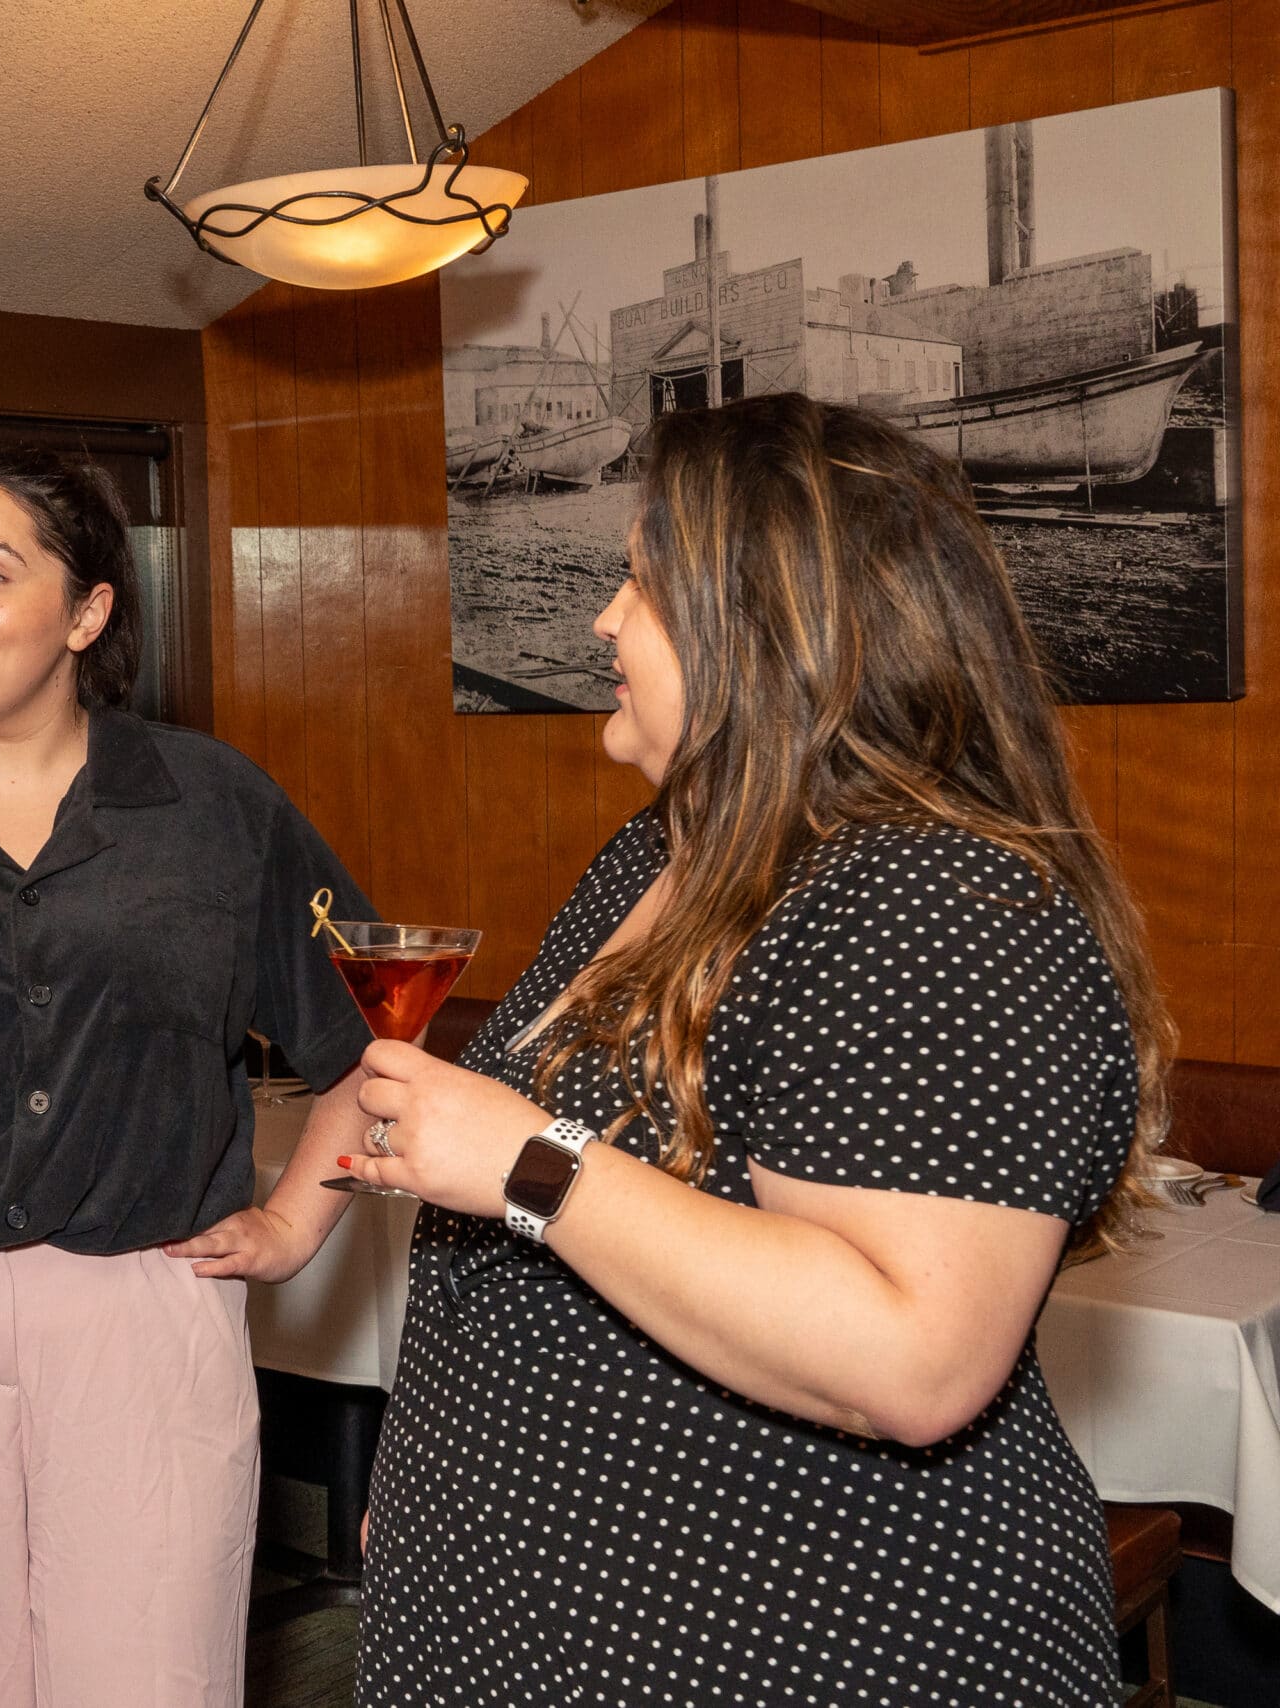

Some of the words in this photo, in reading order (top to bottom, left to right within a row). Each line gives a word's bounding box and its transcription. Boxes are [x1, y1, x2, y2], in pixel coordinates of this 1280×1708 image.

[617, 309, 648, 330] BOAT
[660, 282, 740, 321] BUILDRS
[763, 268, 788, 294] CO
